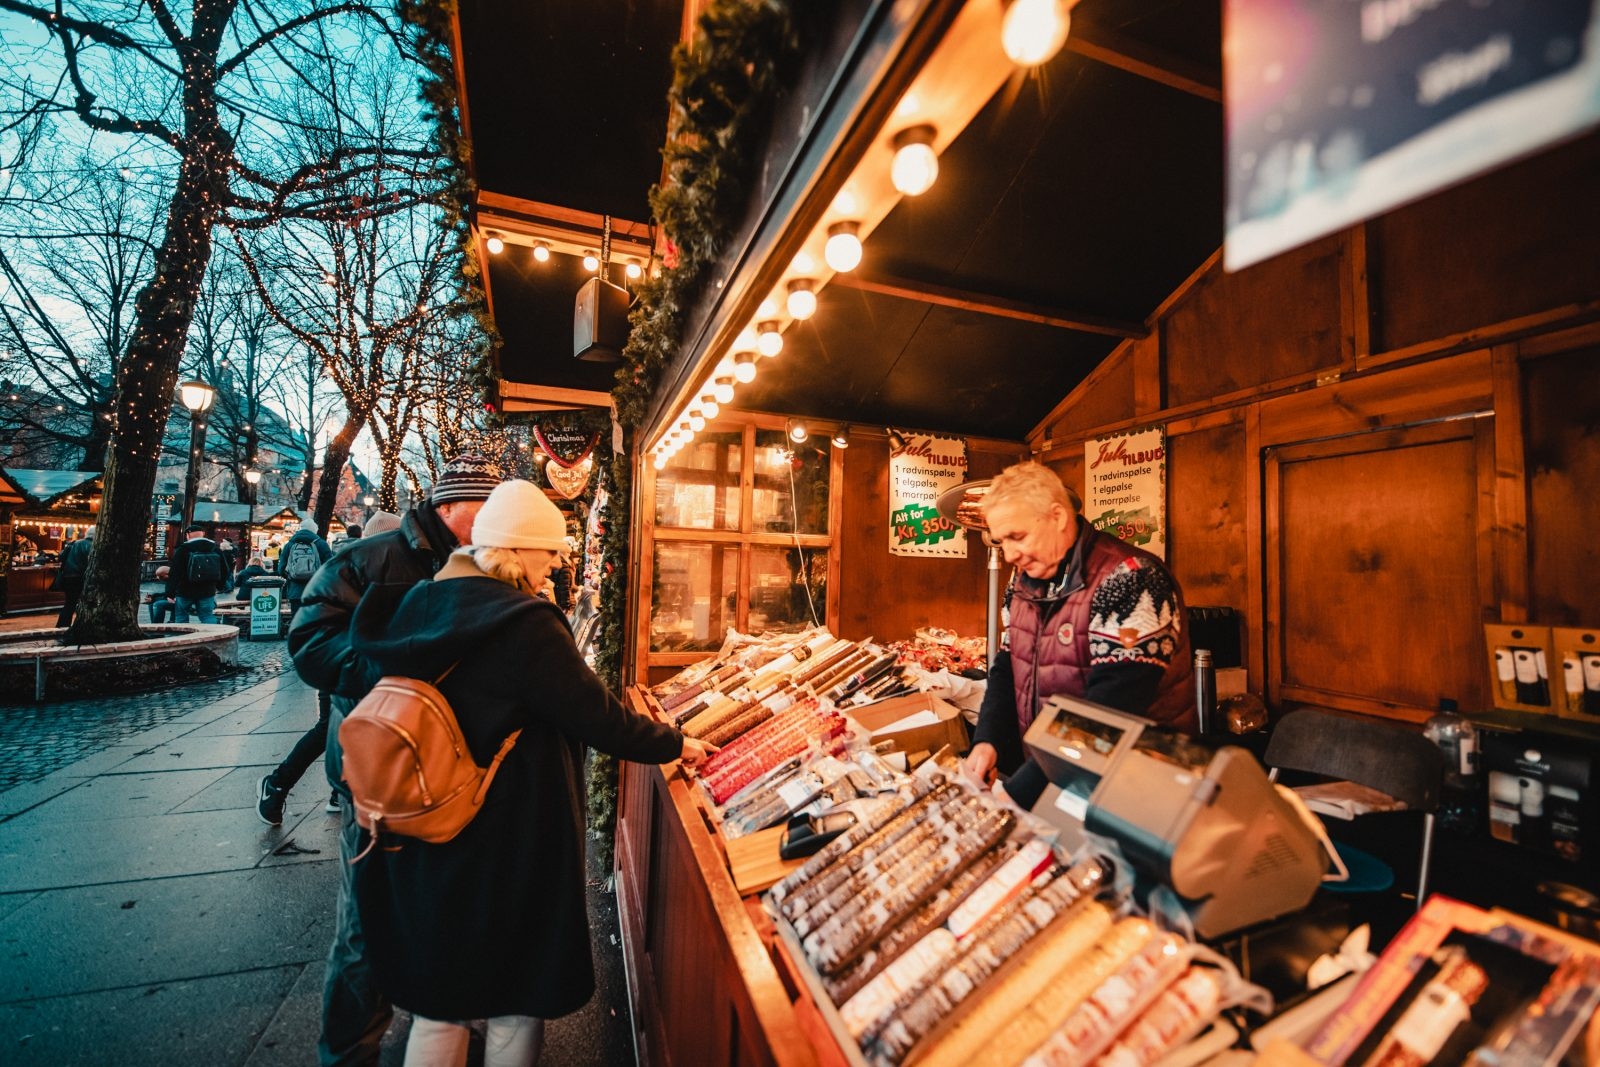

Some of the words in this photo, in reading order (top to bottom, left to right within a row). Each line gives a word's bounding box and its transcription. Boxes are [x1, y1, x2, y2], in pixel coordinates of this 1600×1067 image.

[548, 434, 585, 442] Christmas
[891, 437, 932, 458] Jule
[927, 454, 966, 467] TILBUD
[1090, 439, 1127, 470] Jule
[1122, 447, 1164, 466] TILBUD
[557, 470, 570, 478] God
[572, 471, 582, 480] Jul
[902, 466, 956, 479] rødvinspølse
[1099, 466, 1152, 481] rødvinspølse
[902, 478, 938, 490] elgpølse
[1099, 482, 1133, 495] elgpølse
[902, 491, 940, 503] morrpøl
[1099, 494, 1141, 507] morrpølse
[895, 511, 908, 524] Alt
[910, 509, 924, 520] for
[1094, 520, 1105, 531] Alt
[1106, 515, 1120, 526] for
[897, 524, 918, 540] Kr.
[258, 601, 273, 610] LIFE
